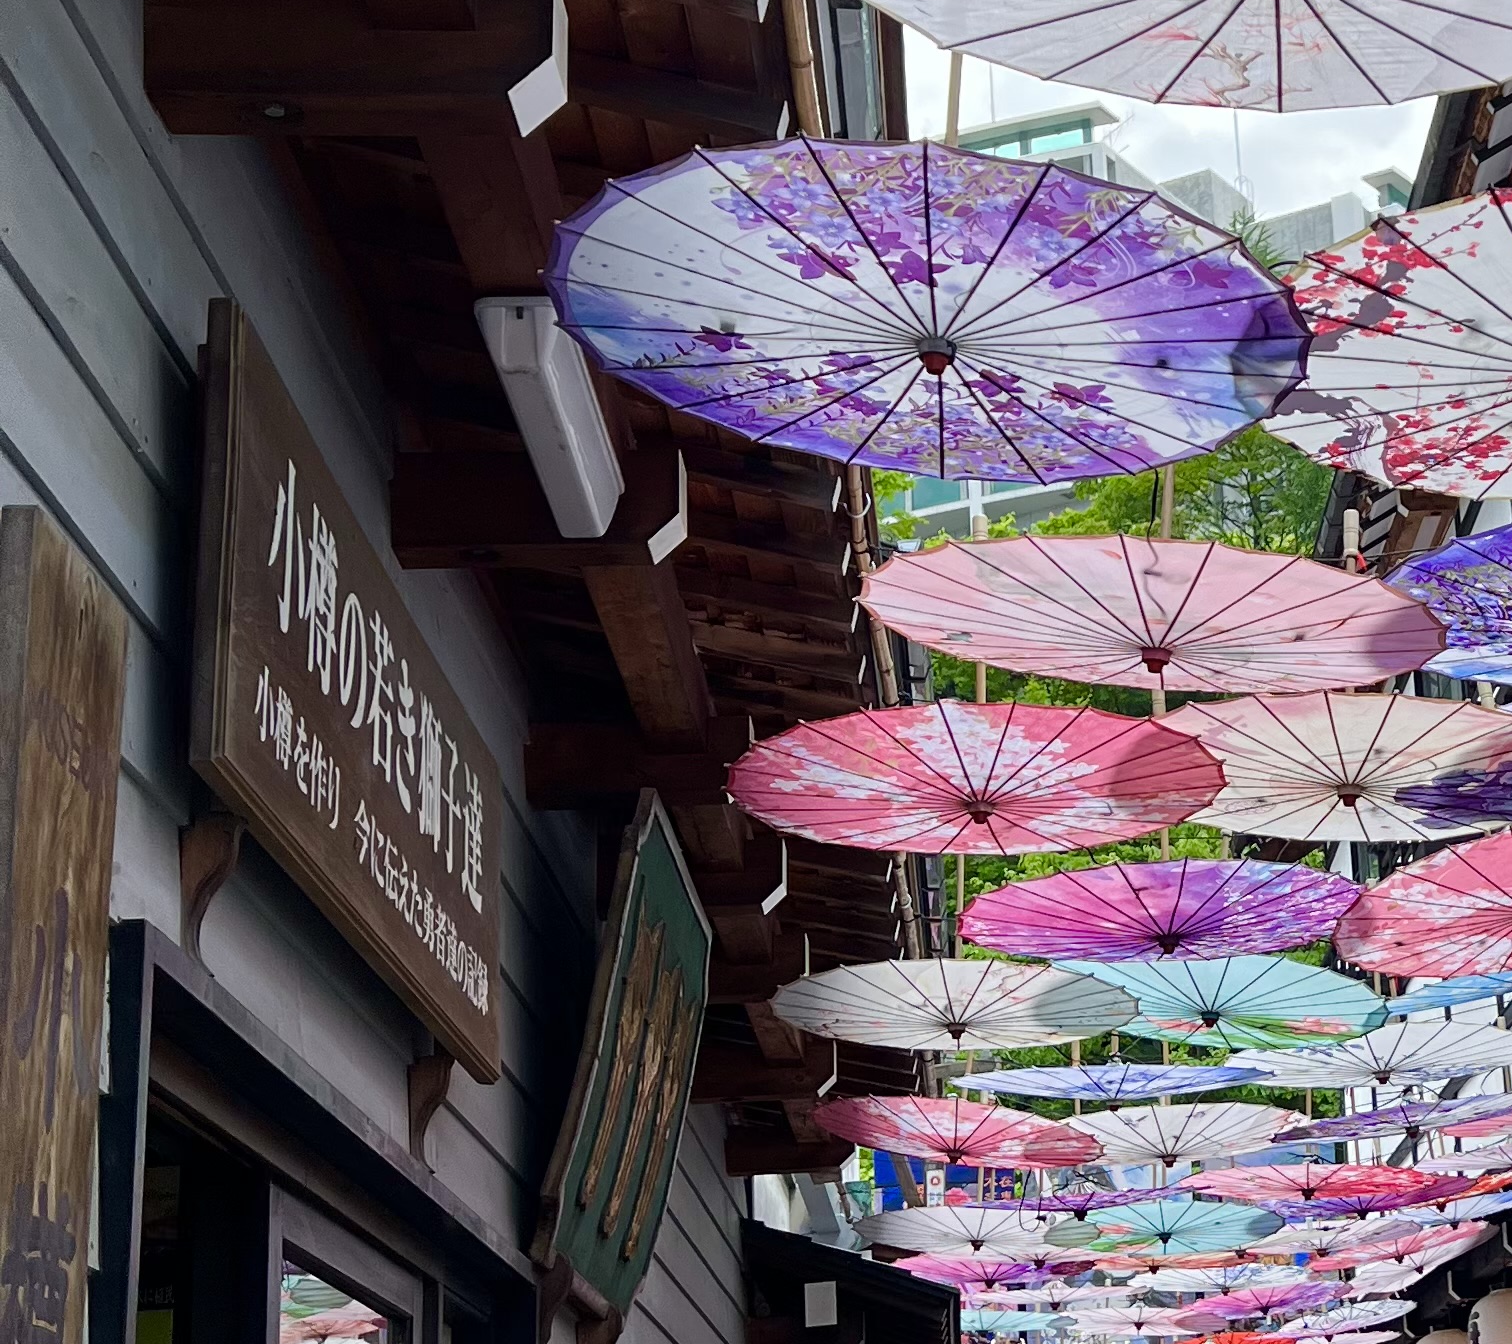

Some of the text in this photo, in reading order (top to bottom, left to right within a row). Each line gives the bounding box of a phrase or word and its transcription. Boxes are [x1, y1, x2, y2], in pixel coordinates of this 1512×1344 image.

[254, 665, 488, 1016] 小樽を作り 今に伝えた勇者達の記録
[268, 458, 482, 914] 小樽の若き獅子達
